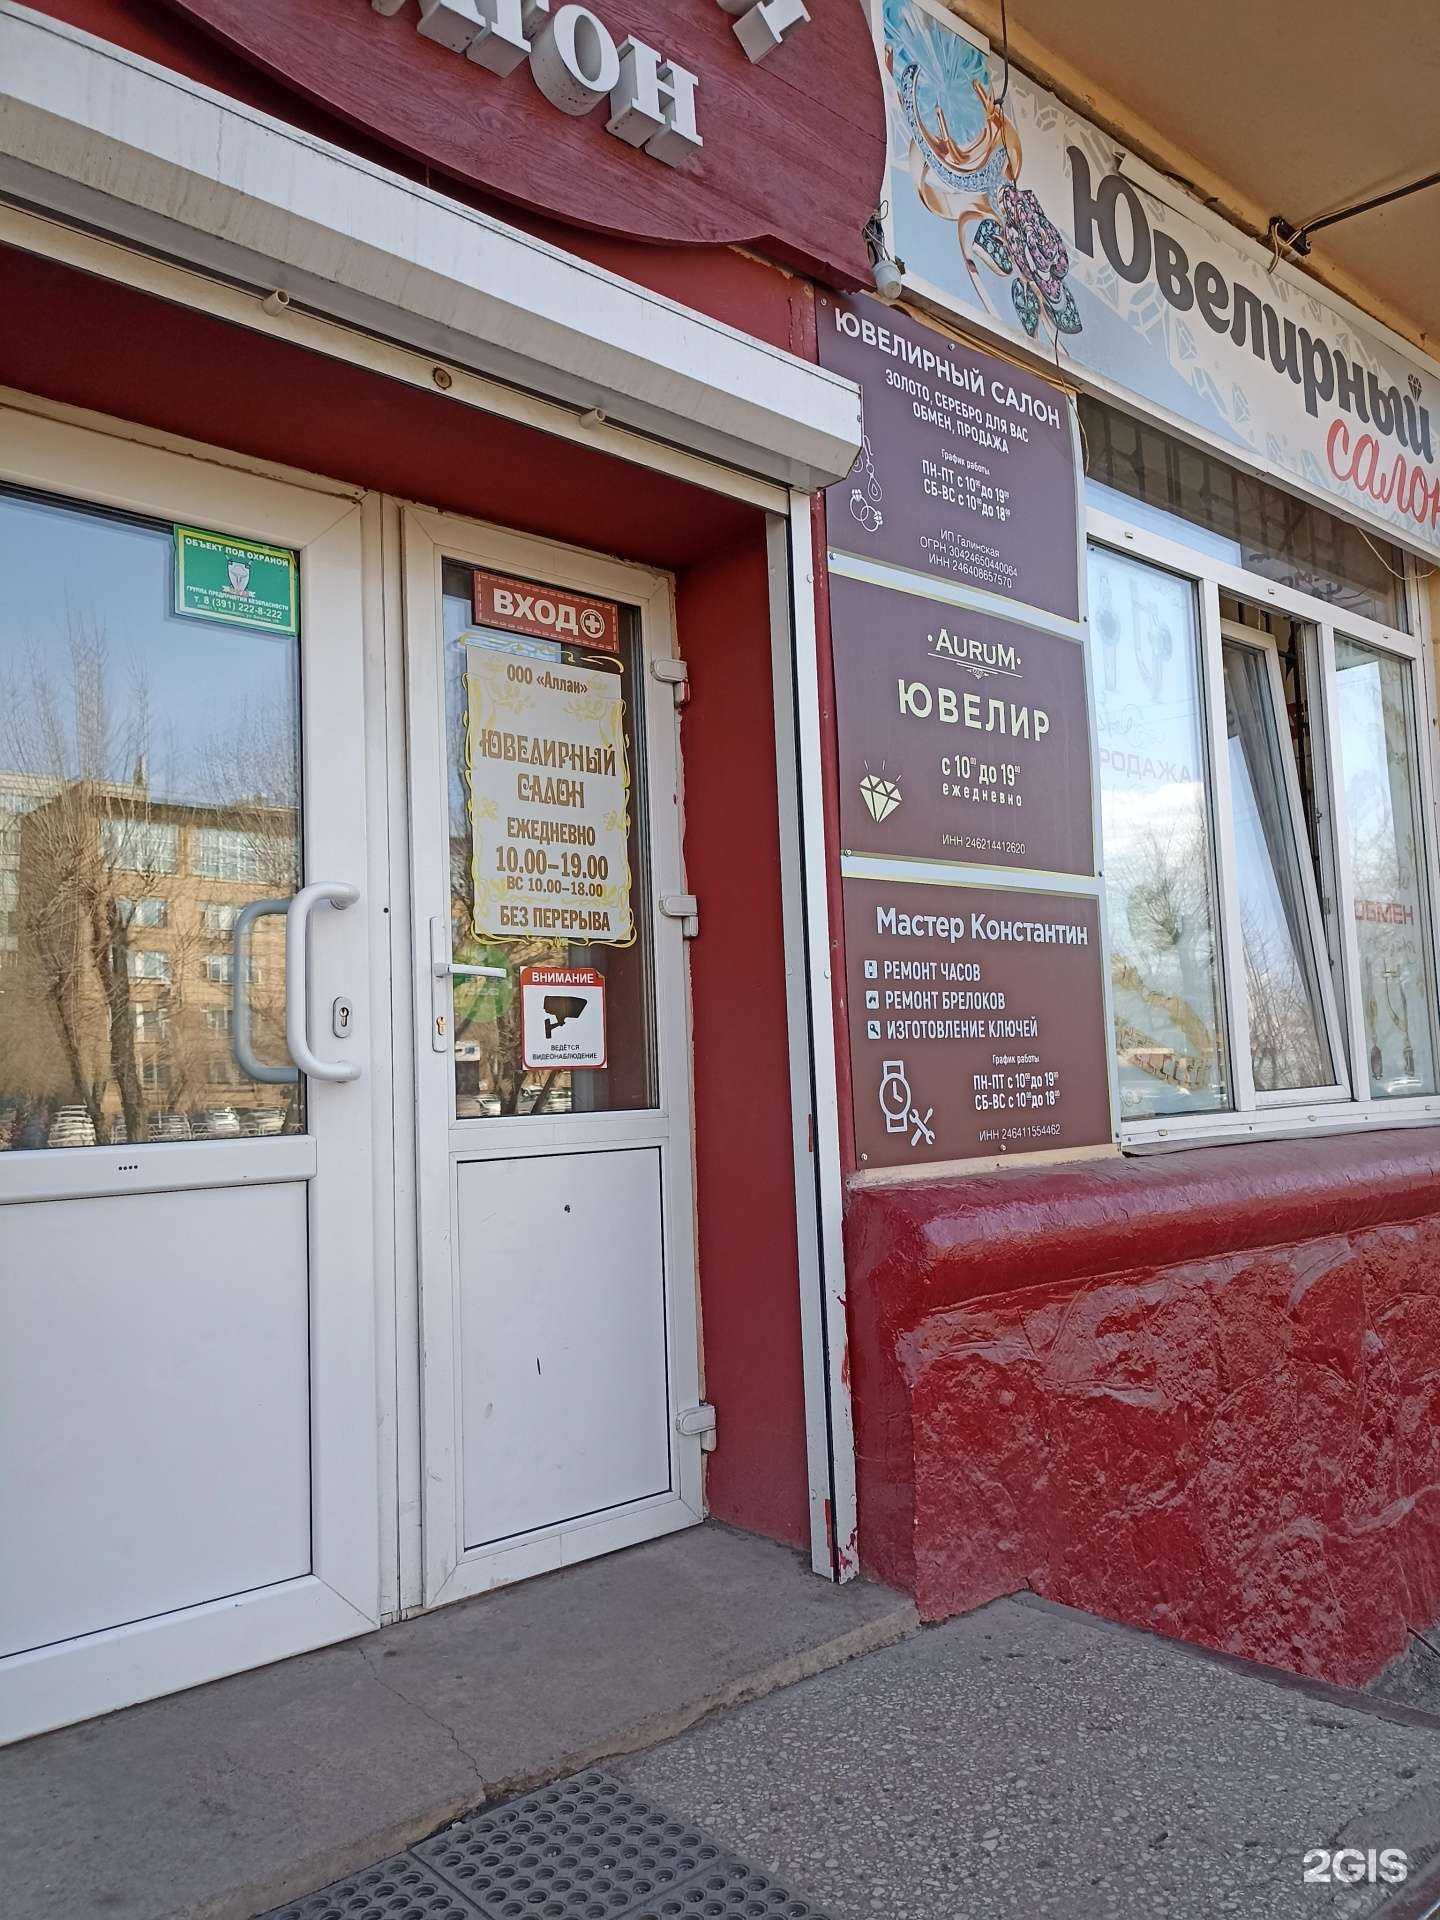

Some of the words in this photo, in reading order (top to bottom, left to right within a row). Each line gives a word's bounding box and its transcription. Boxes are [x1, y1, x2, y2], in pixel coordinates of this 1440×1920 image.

[1067, 145, 1434, 464] Ювелирный
[835, 308, 985, 397] ЮВЕЛИРНЫЙ
[991, 381, 1060, 429] САЛОН
[885, 369, 933, 405] ЗОЛОТО,
[935, 391, 983, 424] СЕРЕБРО
[985, 412, 1007, 432] ДЛЯ
[1010, 423, 1029, 443] ВАС
[913, 402, 955, 434] ОБМЕН,
[957, 423, 1009, 454] ПРОДАЖА
[941, 448, 965, 467] График
[967, 460, 991, 476] работы
[922, 459, 954, 484] ПН-ПТ
[981, 485, 993, 500] до
[924, 478, 955, 503] СБ-ВС
[982, 504, 994, 518] до
[185, 537, 223, 552] ОБЪЕКТ
[225, 546, 246, 558] ПОД
[247, 551, 290, 567] ОХРАНОЙ
[920, 536, 946, 554] ОГРН
[940, 529, 955, 542] ИП
[957, 534, 1000, 558] Галинская
[929, 553, 950, 568] ИНН
[212, 597, 236, 612] (391)
[238, 603, 283, 619] 222-8-222
[493, 588, 579, 636] ВХОД
[506, 663, 533, 685] ООО
[898, 678, 1050, 742] ЮВЕЛИР
[480, 727, 617, 777] ЮВЕЛИРНЫЙ
[978, 764, 997, 785] до
[1099, 748, 1193, 784] РОДАЖА
[517, 773, 585, 809] САЛОН
[943, 782, 1022, 807] ежедневно
[507, 816, 596, 847] ЕЖЕДНЕВНО
[942, 834, 963, 847] ИНН
[506, 875, 524, 890] ВС
[499, 905, 529, 927] БЕЗ
[532, 907, 611, 932] ПЕРЕРЫВА
[876, 906, 965, 943] Мастер
[971, 913, 1089, 945] Константин
[532, 972, 594, 984] ВНИМАНИЕ
[884, 960, 937, 980] РЕМОНТ
[941, 962, 981, 982] ЧАСОВ
[885, 990, 939, 1010] РЕМОНТ
[942, 991, 1006, 1010] БРЕЛОКОВ
[887, 1020, 986, 1039] ИЗГОТОВЛЕНИЕ
[988, 1016, 1038, 1038] КЛЮЧЕЙ
[532, 1052, 598, 1061] ВИДЕОНАБЛЮДЕНИЕ
[992, 1053, 1016, 1066] График
[1016, 1053, 1040, 1066] работы
[973, 1073, 1005, 1090] ПН-ПТ
[1031, 1075, 1043, 1090] до
[975, 1092, 1006, 1111] СБ-ВС
[1031, 1094, 1044, 1109] до
[979, 1129, 1000, 1142] ИНН
